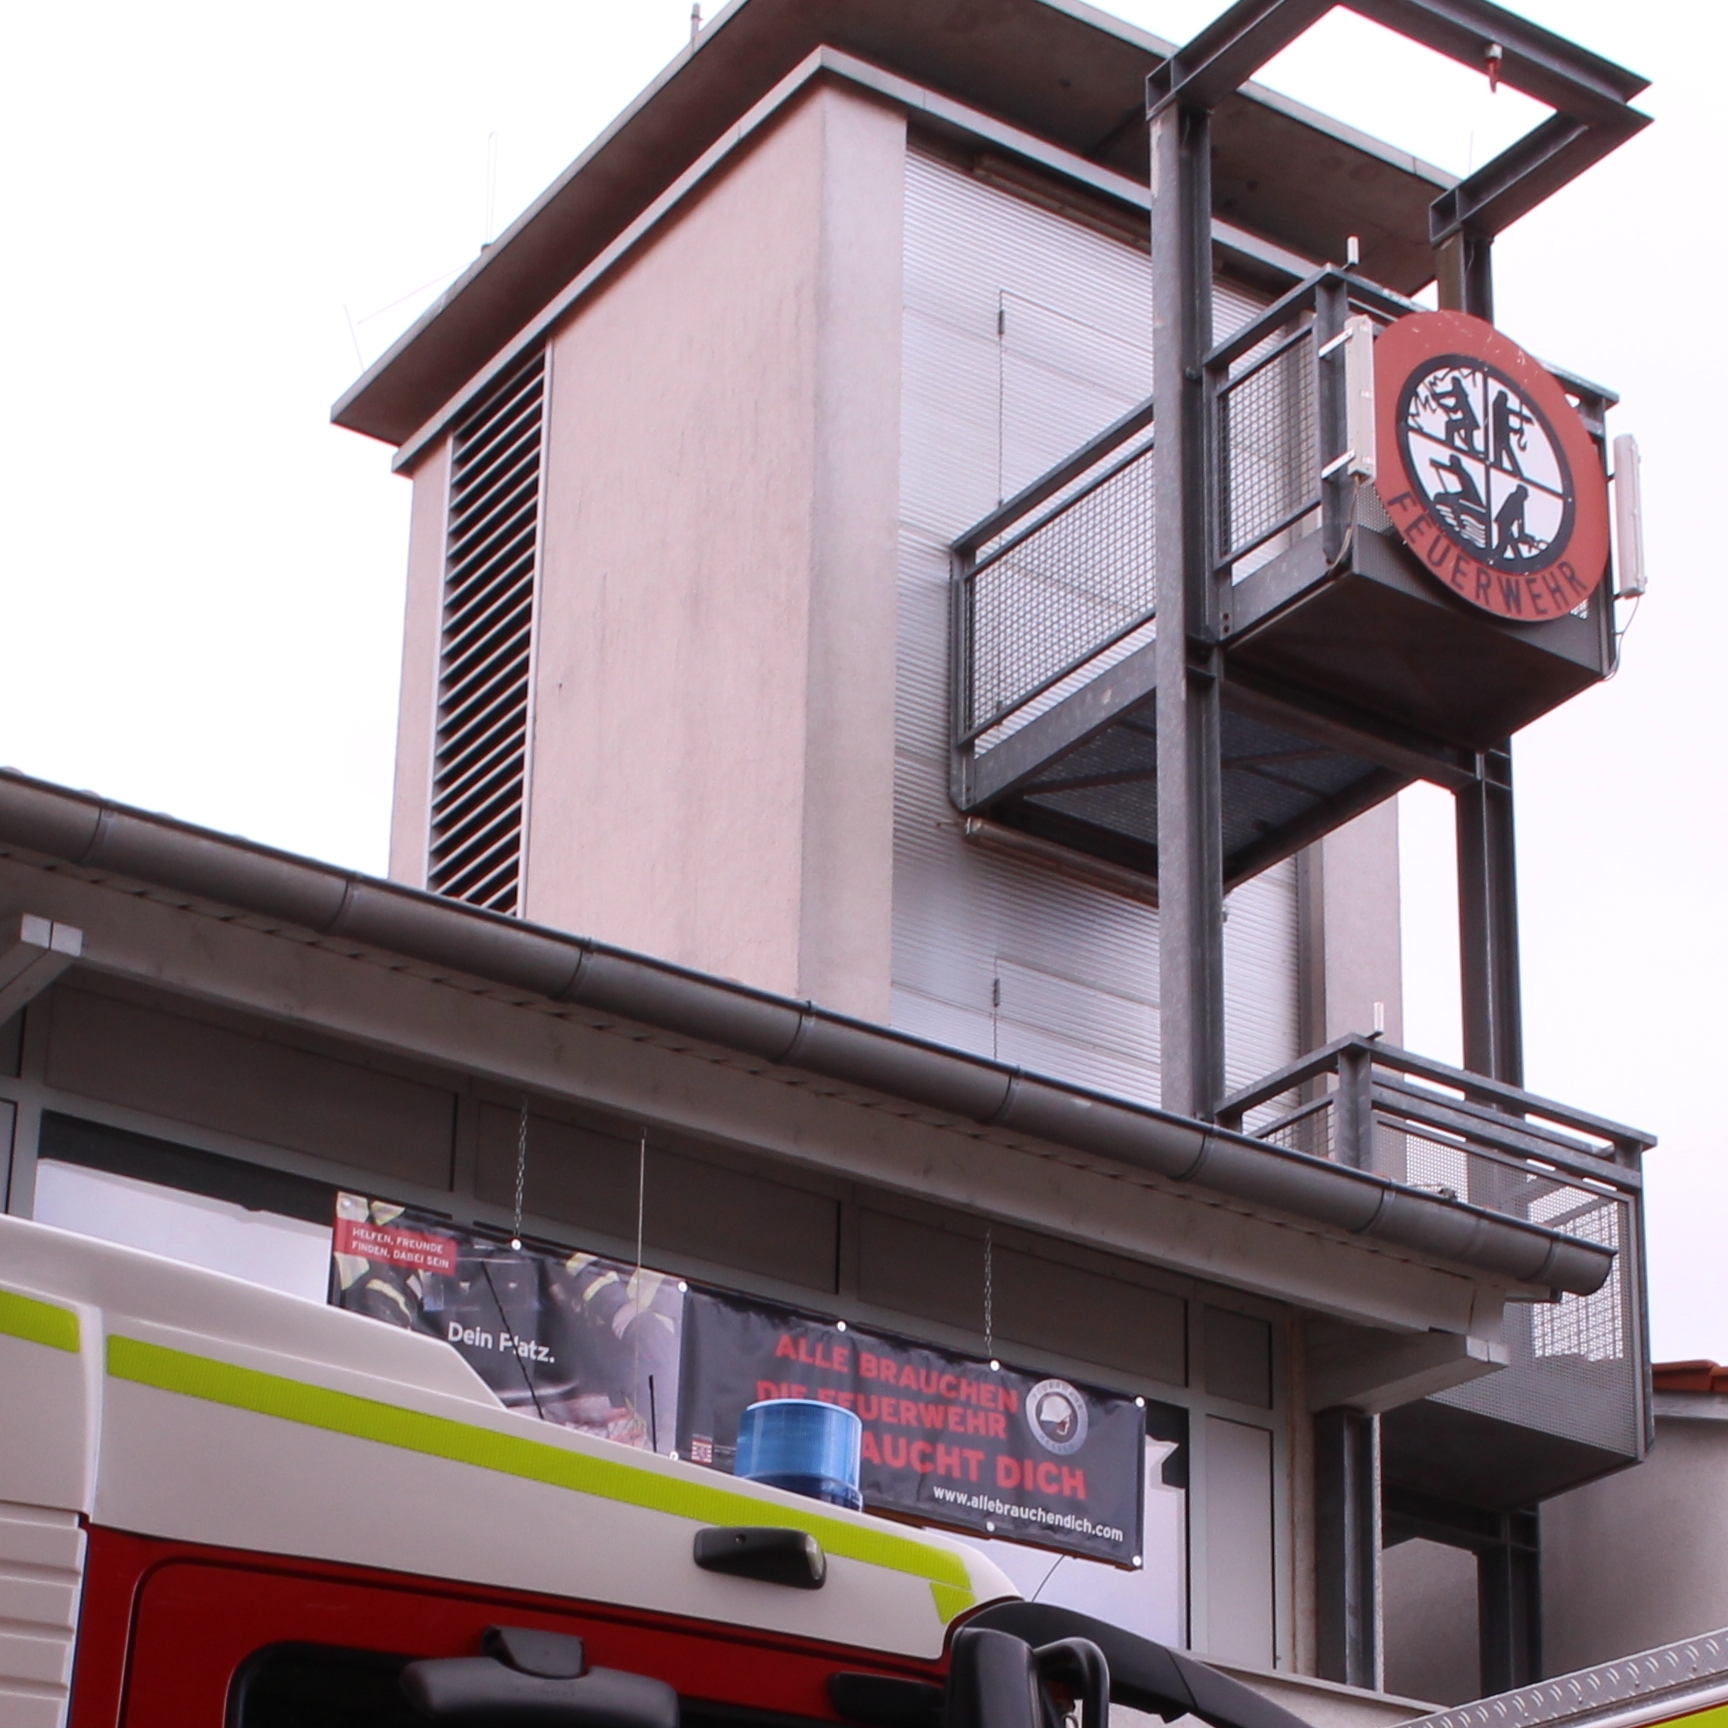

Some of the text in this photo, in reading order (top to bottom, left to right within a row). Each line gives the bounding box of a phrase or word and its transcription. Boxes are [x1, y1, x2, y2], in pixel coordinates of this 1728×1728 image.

[1387, 491, 1588, 615] FEUERWEHR
[352, 1227, 444, 1254] HELFEN, FREUNDE
[352, 1240, 450, 1269] FINDEN, DABEI SEIN
[448, 1321, 493, 1350] Dein
[775, 1334, 849, 1373] ALLE
[858, 1352, 1018, 1414] BRAUCHEN
[862, 1431, 986, 1482] AUCHT
[996, 1454, 1087, 1500] DICH
[933, 1485, 1124, 1543] www.allebrauchendich.com
